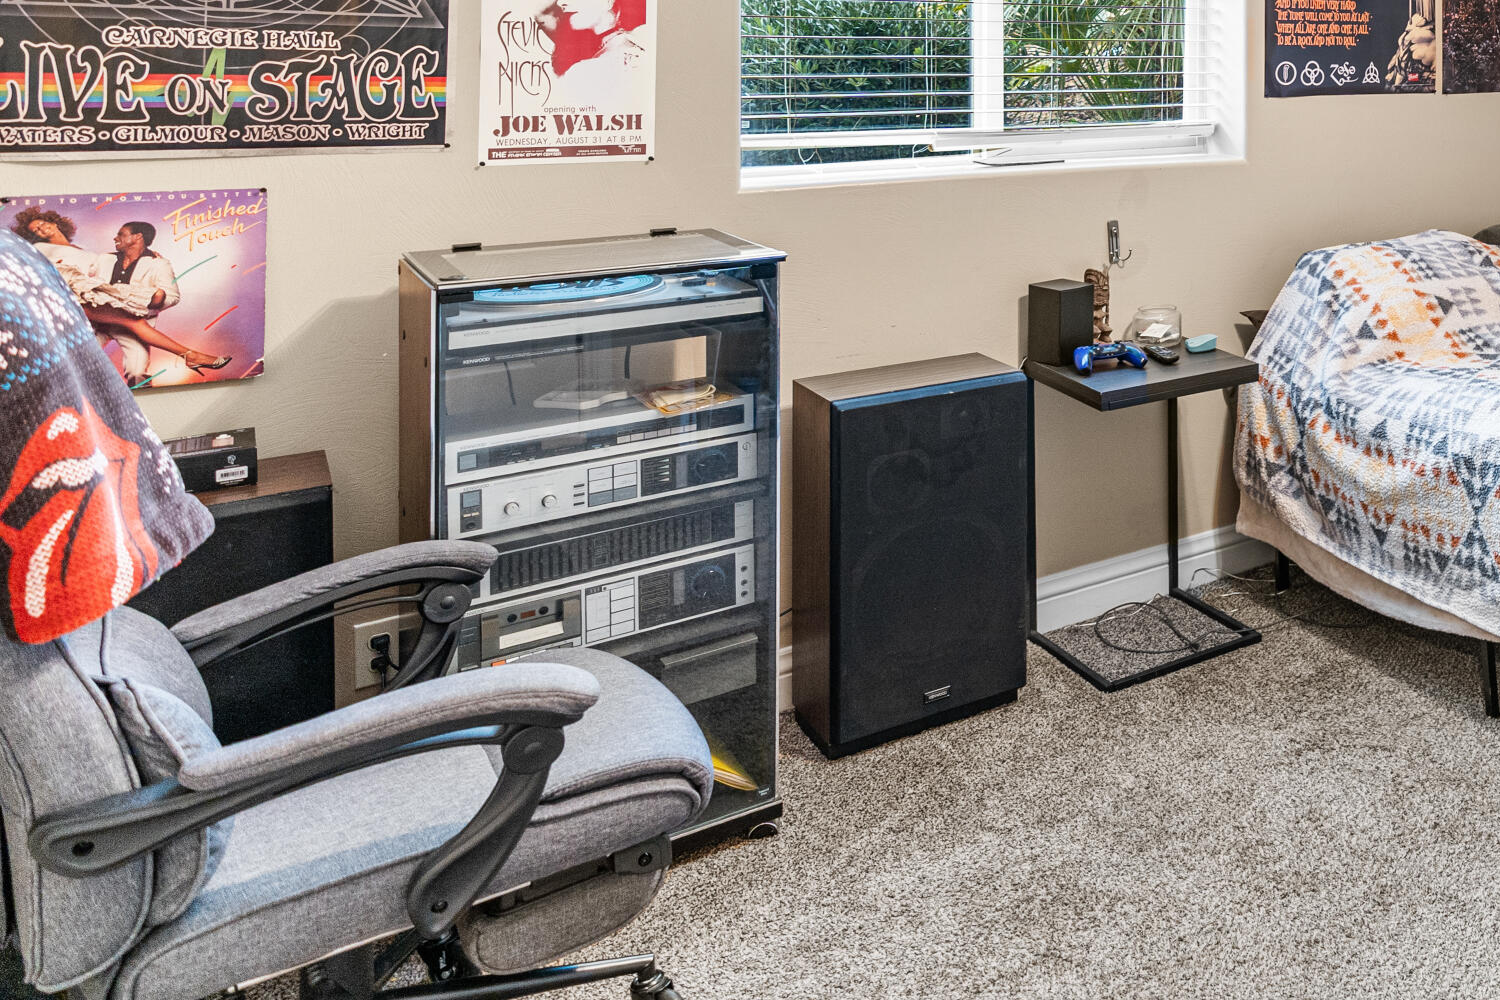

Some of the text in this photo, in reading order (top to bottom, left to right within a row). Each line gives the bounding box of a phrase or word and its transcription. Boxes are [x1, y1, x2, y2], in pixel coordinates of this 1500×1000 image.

[102, 25, 341, 50] CARNEGIE HALL
[163, 72, 232, 116] ON
[245, 44, 440, 124] STAGE
[111, 124, 229, 145] GILMOUR
[242, 124, 331, 141] MASON
[345, 123, 430, 140] WRIGHT
[493, 114, 643, 137] JOE WALSH
[495, 138, 551, 146] WEDNESDAY,
[92, 195, 143, 204] KNOW
[162, 197, 267, 235] Finished
[174, 217, 262, 251] Touch
[462, 356, 491, 365] KENWOOD
